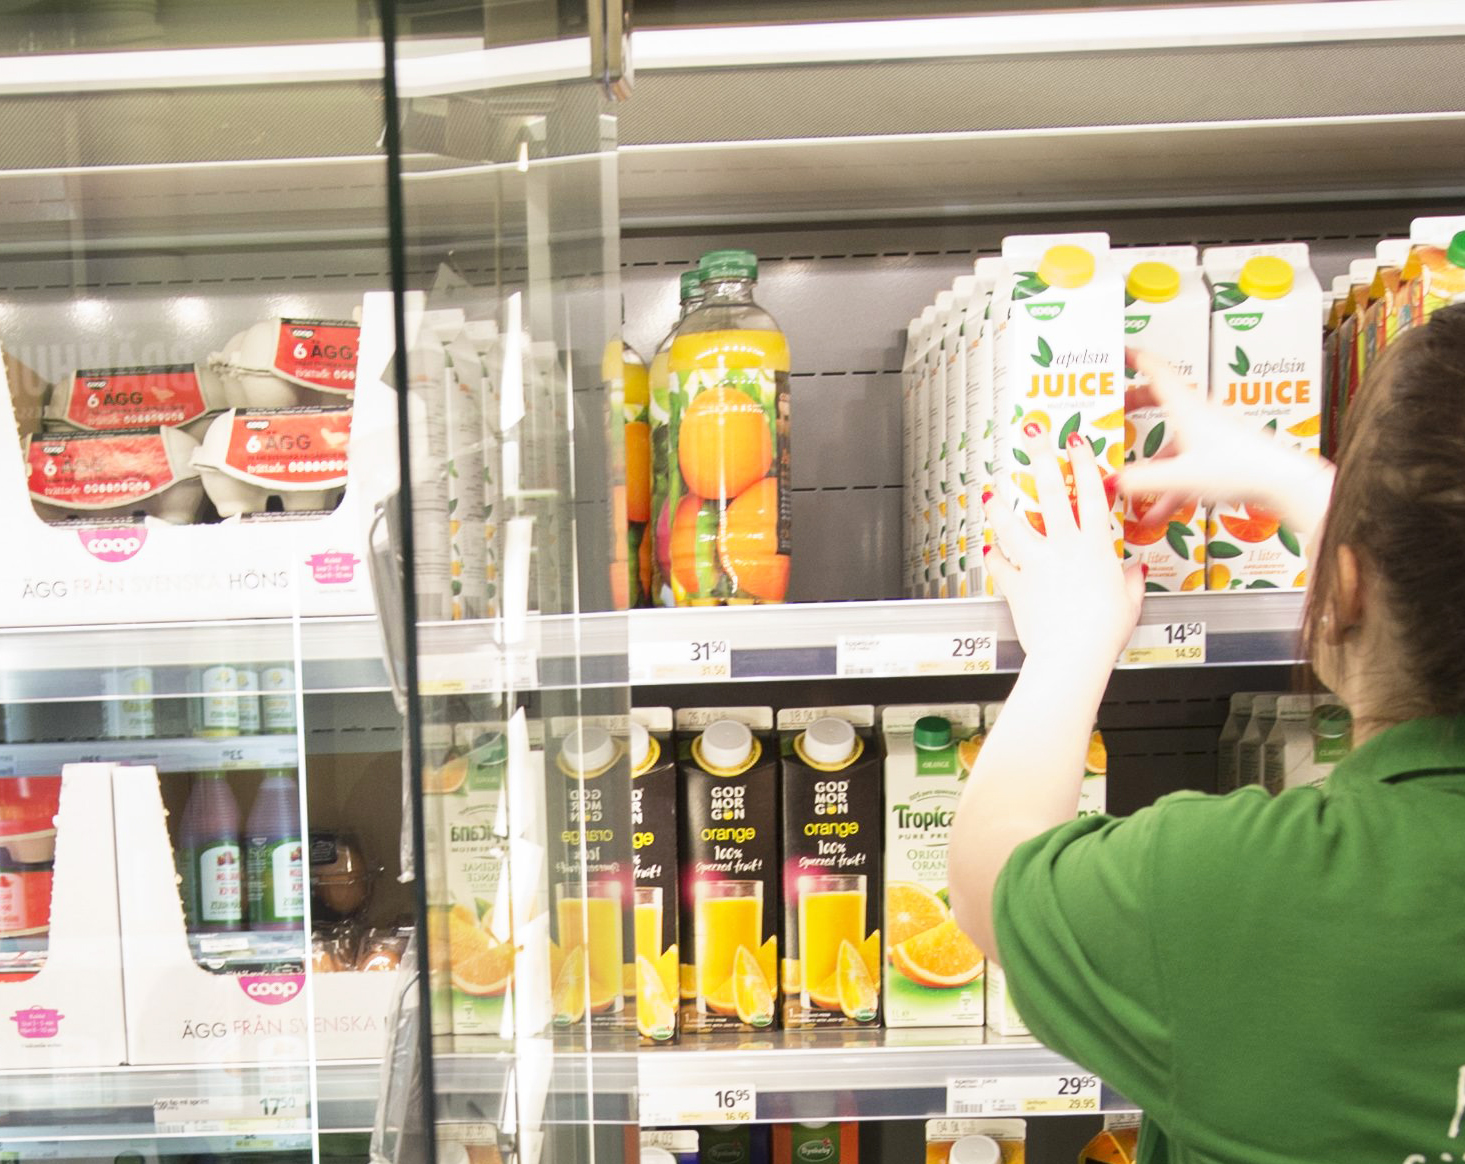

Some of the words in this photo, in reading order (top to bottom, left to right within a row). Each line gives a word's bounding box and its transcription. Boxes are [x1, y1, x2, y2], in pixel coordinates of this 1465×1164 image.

[311, 340, 353, 360] ÄGG
[1056, 348, 1111, 369] apelsin
[1252, 357, 1306, 377] apelsin
[1025, 371, 1115, 398] JUICE
[1222, 379, 1311, 406] JUICE
[102, 391, 143, 406] ÄGG
[246, 436, 262, 453] 6
[265, 430, 311, 451] ÄGG
[88, 537, 140, 555] coop
[22, 579, 67, 599] ÄGG
[229, 569, 288, 590] HÖNS
[711, 786, 744, 798] GOD
[814, 781, 848, 793] GOD
[711, 798, 744, 809] MOR
[814, 793, 848, 804] MOR
[701, 825, 756, 844] orange
[803, 819, 859, 838] orange
[246, 981, 298, 998] coop
[182, 1021, 227, 1039] ÄGG
[233, 1015, 283, 1035] FRÅN
[1067, 1098, 1096, 1110] 29.95
